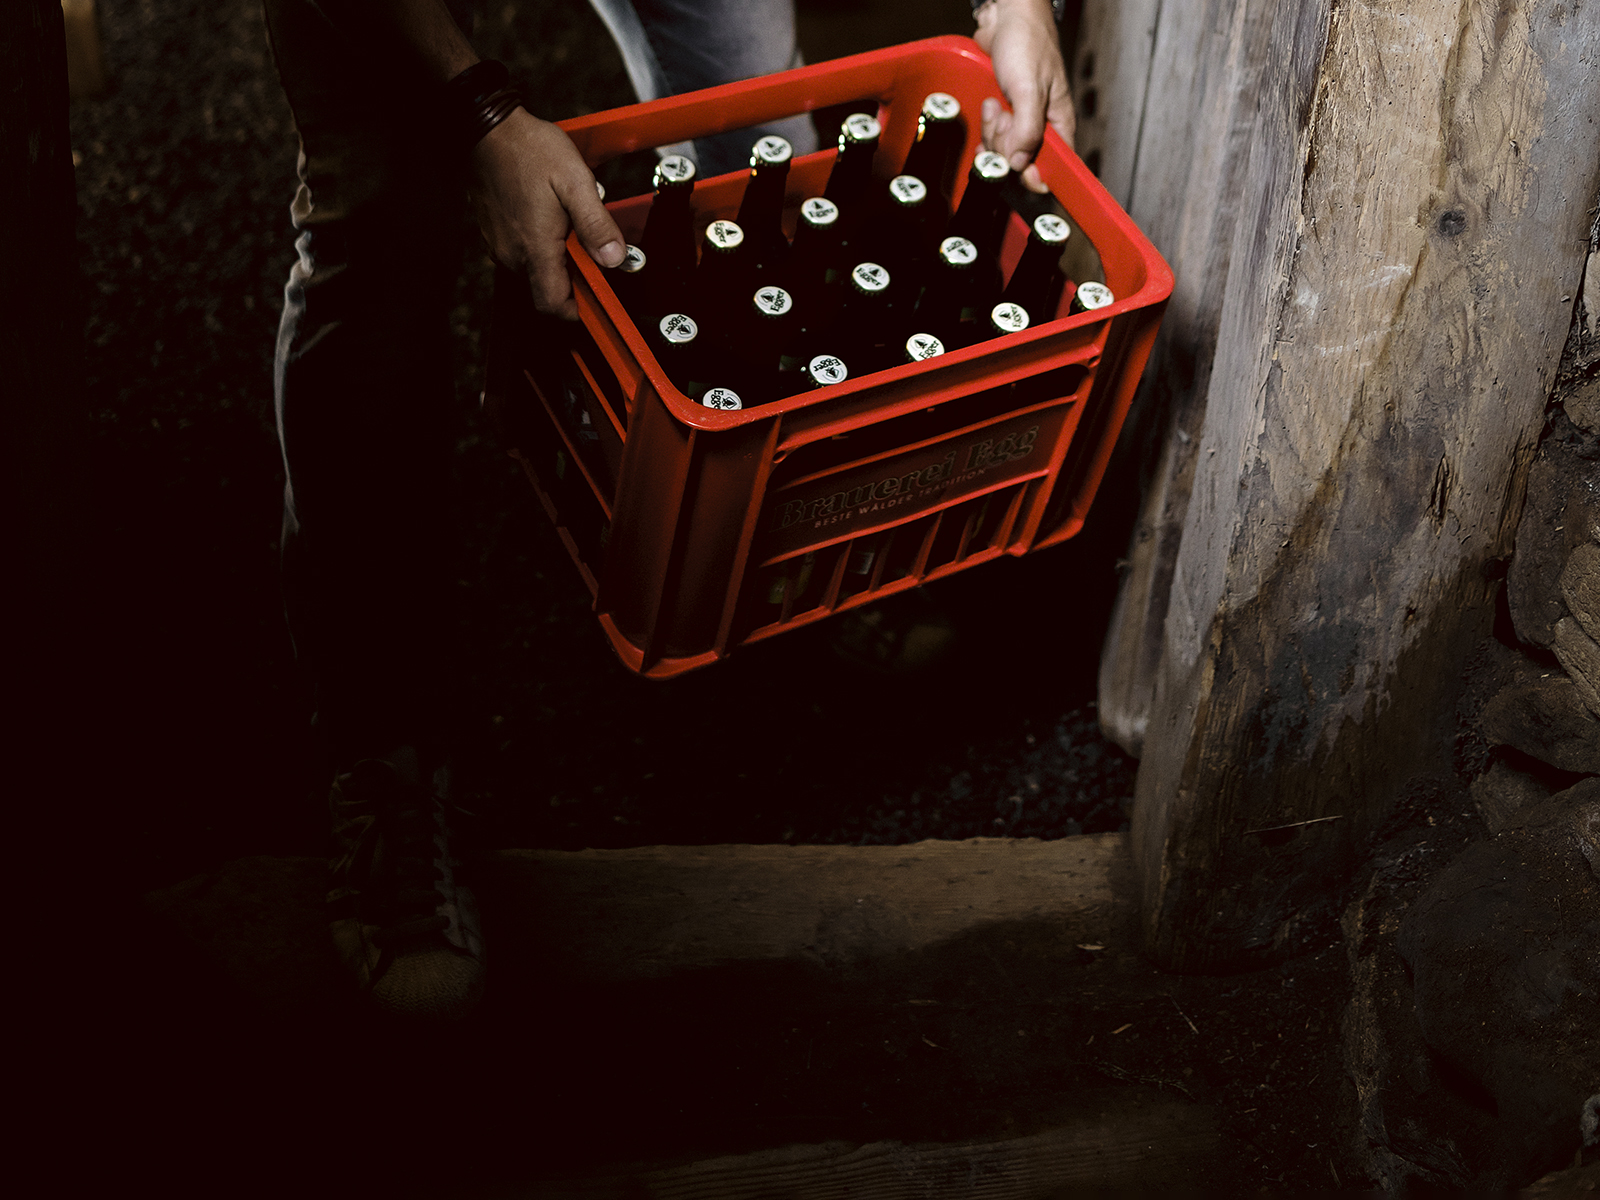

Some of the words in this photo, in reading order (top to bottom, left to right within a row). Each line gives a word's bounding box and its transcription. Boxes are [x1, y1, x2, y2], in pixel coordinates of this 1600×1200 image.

[856, 268, 882, 286] Egger
[770, 290, 785, 312] Egger
[665, 314, 687, 334] Egger
[919, 341, 939, 359] Egger
[814, 358, 841, 371] Egger
[711, 390, 724, 410] Egge
[769, 450, 957, 533] Brauerei
[962, 425, 1039, 471] Egg
[814, 510, 853, 528] BESTE
[918, 469, 986, 497] TRADITION
